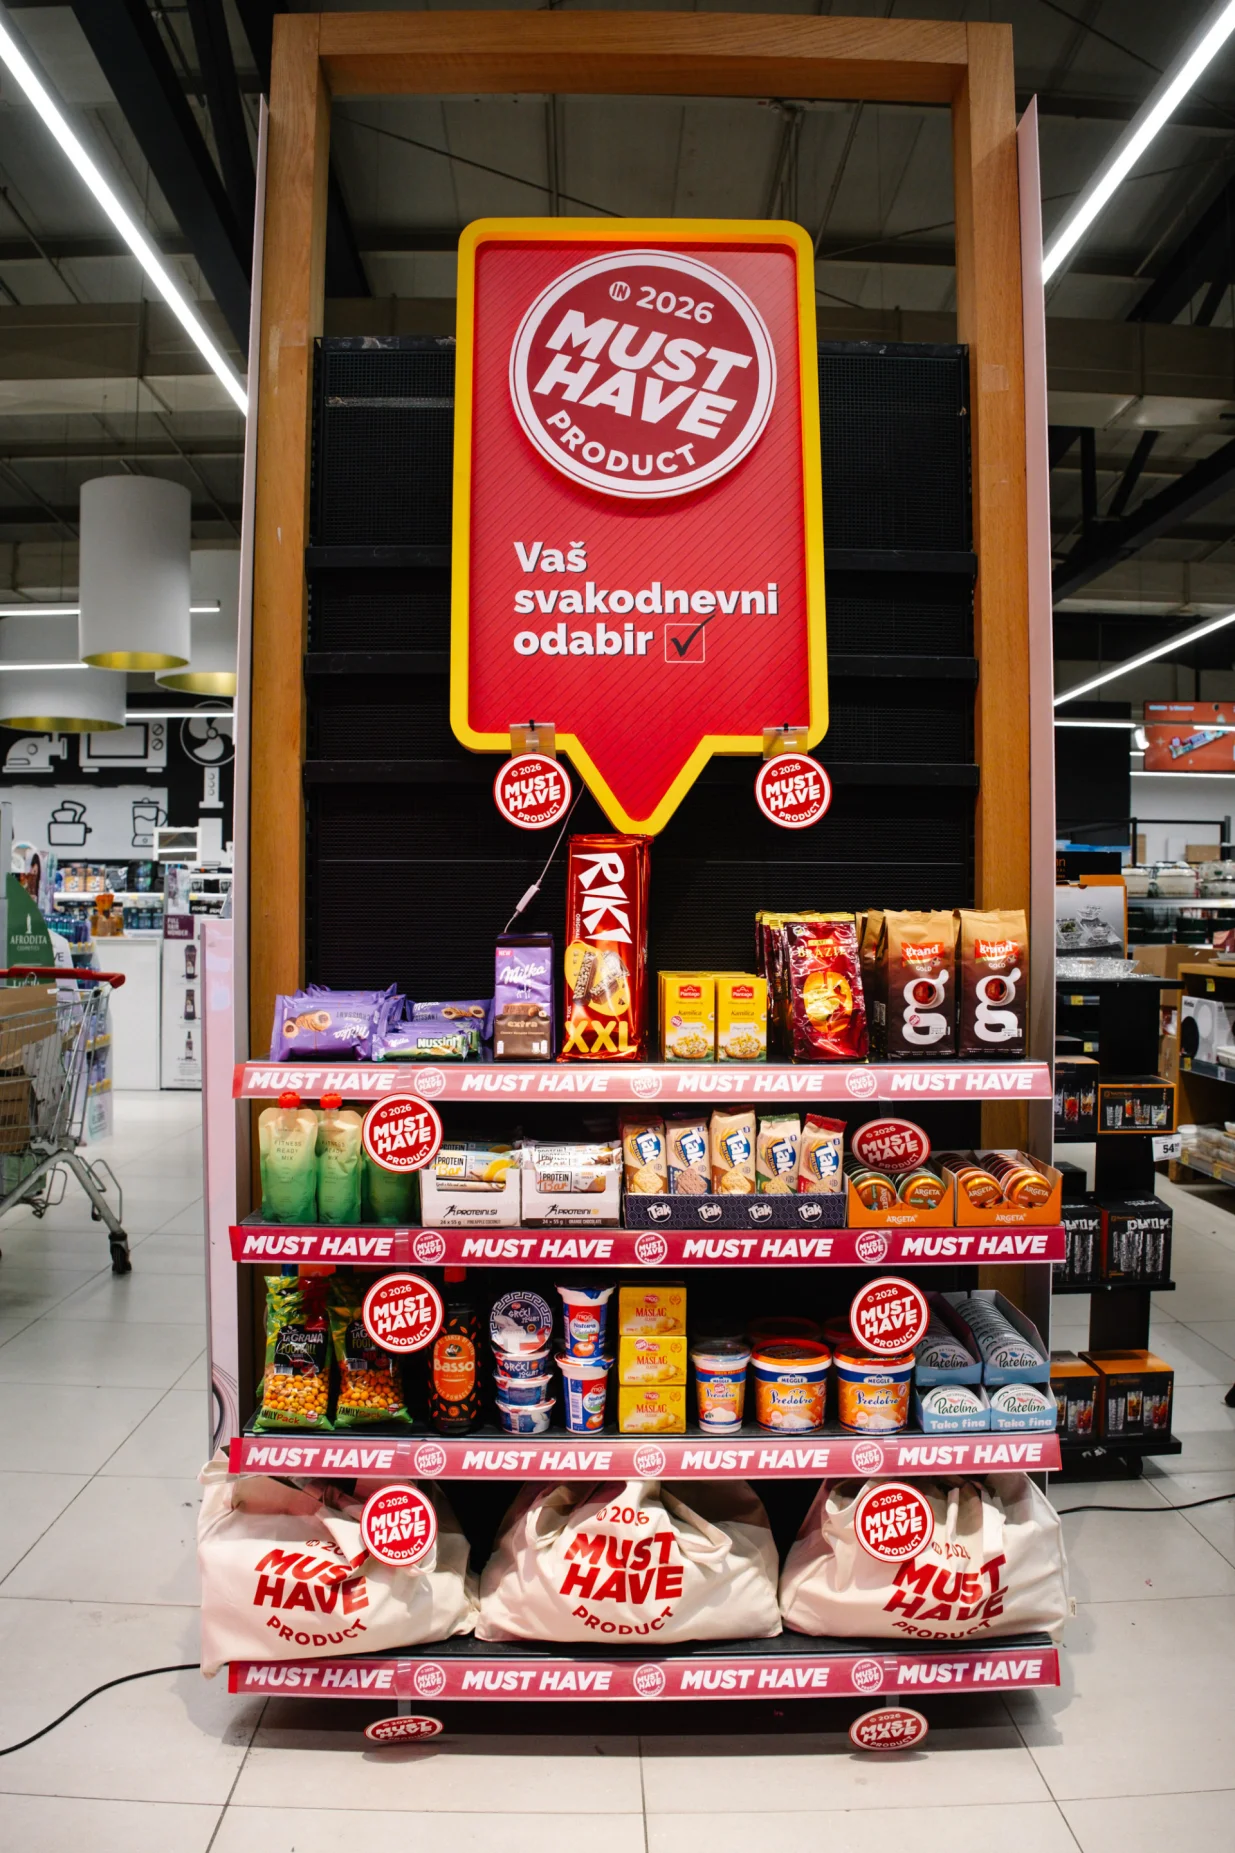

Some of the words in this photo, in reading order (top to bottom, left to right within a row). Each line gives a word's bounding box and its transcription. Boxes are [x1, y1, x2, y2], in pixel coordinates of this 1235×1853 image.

[636, 285, 715, 324] 2026
[545, 309, 753, 392] MUST
[533, 354, 738, 439] HAVE
[546, 410, 697, 476] PRODUCT
[513, 540, 588, 573] Vaš
[513, 582, 779, 615] svakodnevni
[513, 623, 654, 655] odabir
[519, 763, 542, 776] 2026
[779, 763, 801, 776] 2026
[505, 771, 558, 799] MUST
[765, 771, 817, 799] MUST
[509, 785, 561, 812] HAVE
[770, 784, 821, 812] HAVE
[517, 802, 560, 822] PRODUCT
[779, 801, 821, 822] PRODUCT
[9, 935, 48, 944] AFRODITA
[906, 944, 939, 957] grand
[500, 962, 547, 985] Milka
[915, 964, 932, 972] GOLD
[507, 1019, 538, 1028] extra
[562, 1020, 639, 1053] XXL
[248, 1071, 322, 1090] MUST
[320, 1072, 396, 1091] HAVE
[462, 1073, 535, 1092] MUST
[532, 1073, 608, 1092] HAVE
[677, 1074, 753, 1092] MUST
[753, 1074, 825, 1091] HAVE
[891, 1073, 965, 1091] MUST
[964, 1072, 1033, 1090] HAVE
[388, 1104, 412, 1116] 2026
[374, 1112, 428, 1141] MUST
[873, 1126, 896, 1137] 2026
[274, 1140, 302, 1148] FITNESS
[378, 1126, 431, 1155] HAVE
[636, 1129, 659, 1164] Tak
[681, 1129, 705, 1166] Tak
[726, 1130, 750, 1167] Tak
[862, 1131, 913, 1155] MUST
[1163, 1144, 1175, 1154] 54
[386, 1145, 430, 1165] PRODUCT
[438, 1156, 464, 1166] PROTEIN
[772, 1138, 794, 1175] Tak
[816, 1142, 838, 1179] Tak
[868, 1140, 919, 1163] HAVE
[879, 1153, 920, 1169] PRODUCT
[432, 1162, 463, 1176] Bar
[543, 1173, 569, 1182] PROTEIN
[537, 1180, 567, 1191] Bar
[914, 1187, 940, 1197] ARGETA
[968, 1186, 994, 1198] ARGETA
[1024, 1185, 1049, 1197] ARGETA
[647, 1204, 671, 1219] Tak
[698, 1204, 721, 1219] Tak
[748, 1204, 772, 1219] Tak
[798, 1204, 822, 1219] Tak
[243, 1236, 319, 1255] MUST
[320, 1237, 394, 1256] HAVE
[462, 1239, 537, 1258] MUST
[535, 1239, 614, 1258] HAVE
[682, 1239, 759, 1258] MUST
[760, 1238, 833, 1257] HAVE
[902, 1237, 977, 1256] MUST
[978, 1235, 1048, 1254] HAVE
[388, 1285, 412, 1297] 2026
[875, 1288, 899, 1301] 2026
[374, 1293, 428, 1322] MUST
[508, 1308, 531, 1318] GRČKI
[635, 1307, 667, 1318] MASLAC
[861, 1295, 915, 1325] MUST
[378, 1306, 431, 1335] HAVE
[865, 1309, 917, 1339] HAVE
[386, 1324, 430, 1345] PRODUCT
[873, 1327, 916, 1348] PRODUCT
[504, 1361, 530, 1372] GRČKI
[636, 1355, 668, 1366] MASLAC
[926, 1352, 969, 1368] Patelina
[995, 1352, 1038, 1369] Patelina
[770, 1389, 813, 1405] Predobro
[856, 1389, 898, 1406] Predobro
[934, 1397, 979, 1415] Patelina
[1003, 1396, 1046, 1413] Patelina
[277, 1410, 299, 1424] Pack
[339, 1405, 359, 1416] FAMILY
[635, 1404, 667, 1415] MASLAC
[930, 1420, 959, 1430] Tako
[962, 1419, 986, 1429] fina
[997, 1418, 1026, 1428] Tako
[1029, 1417, 1052, 1427] fina
[246, 1447, 321, 1467] MUST
[322, 1449, 395, 1468] HAVE
[462, 1450, 537, 1470] MUST
[536, 1450, 613, 1470] HAVE
[681, 1449, 756, 1469] MUST
[757, 1448, 830, 1468] HAVE
[897, 1446, 970, 1466] MUST
[974, 1443, 1042, 1463] HAVE
[385, 1496, 408, 1508] 2026
[880, 1493, 903, 1505] 2026
[371, 1505, 425, 1532] MUST
[865, 1502, 919, 1531] MUST
[374, 1519, 426, 1546] HAVE
[869, 1516, 922, 1544] HAVE
[381, 1539, 424, 1559] PRODUCT
[564, 1532, 677, 1571] MUST
[878, 1534, 922, 1555] PRODUCT
[559, 1563, 683, 1605] HAVE
[892, 1553, 1006, 1604] MUST
[253, 1574, 370, 1615] HAVE
[882, 1586, 1009, 1621] HAVE
[572, 1605, 674, 1635] PRODUCT
[891, 1619, 991, 1640] PRODUCT
[266, 1615, 367, 1647] PRODUCT
[245, 1667, 319, 1687] MUST
[321, 1669, 394, 1689] HAVE
[461, 1671, 536, 1691] MUST
[536, 1671, 612, 1691] HAVE
[681, 1669, 755, 1689] MUST
[758, 1668, 830, 1688] HAVE
[898, 1664, 970, 1684] MUST
[974, 1660, 1042, 1681] HAVE
[860, 1718, 916, 1736] MUST
[863, 1726, 917, 1743] HAVE
